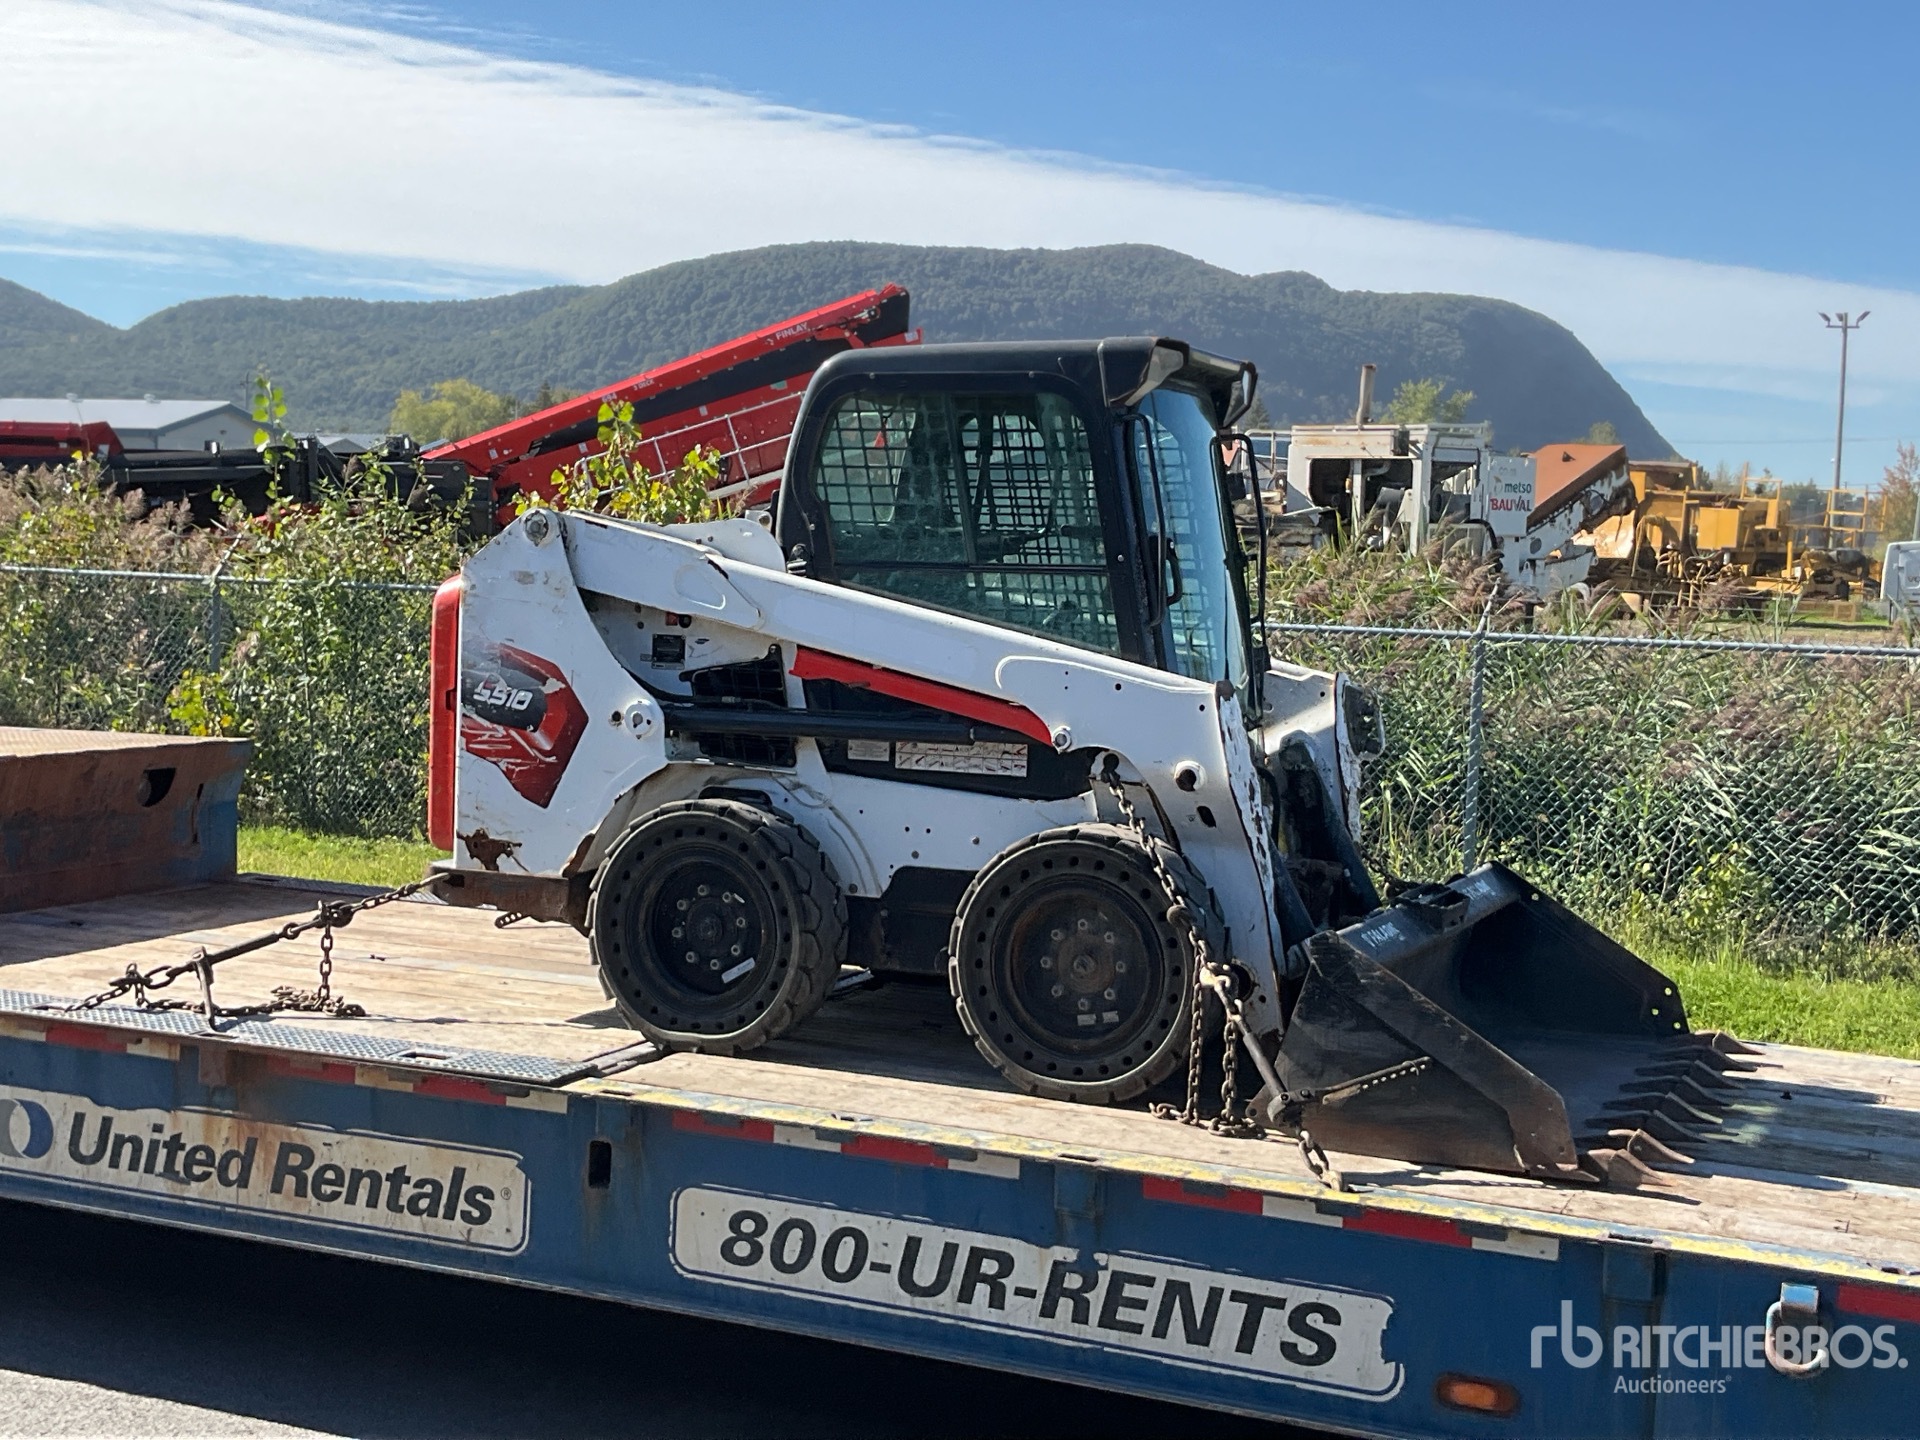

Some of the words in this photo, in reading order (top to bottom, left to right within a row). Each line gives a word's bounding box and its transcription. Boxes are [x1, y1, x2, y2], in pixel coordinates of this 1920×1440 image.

[775, 322, 808, 340] FINLAY
[1504, 482, 1532, 493] metso
[1490, 495, 1532, 511] BAUVAL
[68, 1111, 260, 1189] United
[269, 1141, 497, 1226] Rentals
[720, 1209, 1343, 1367] 800-UR-RENTS
